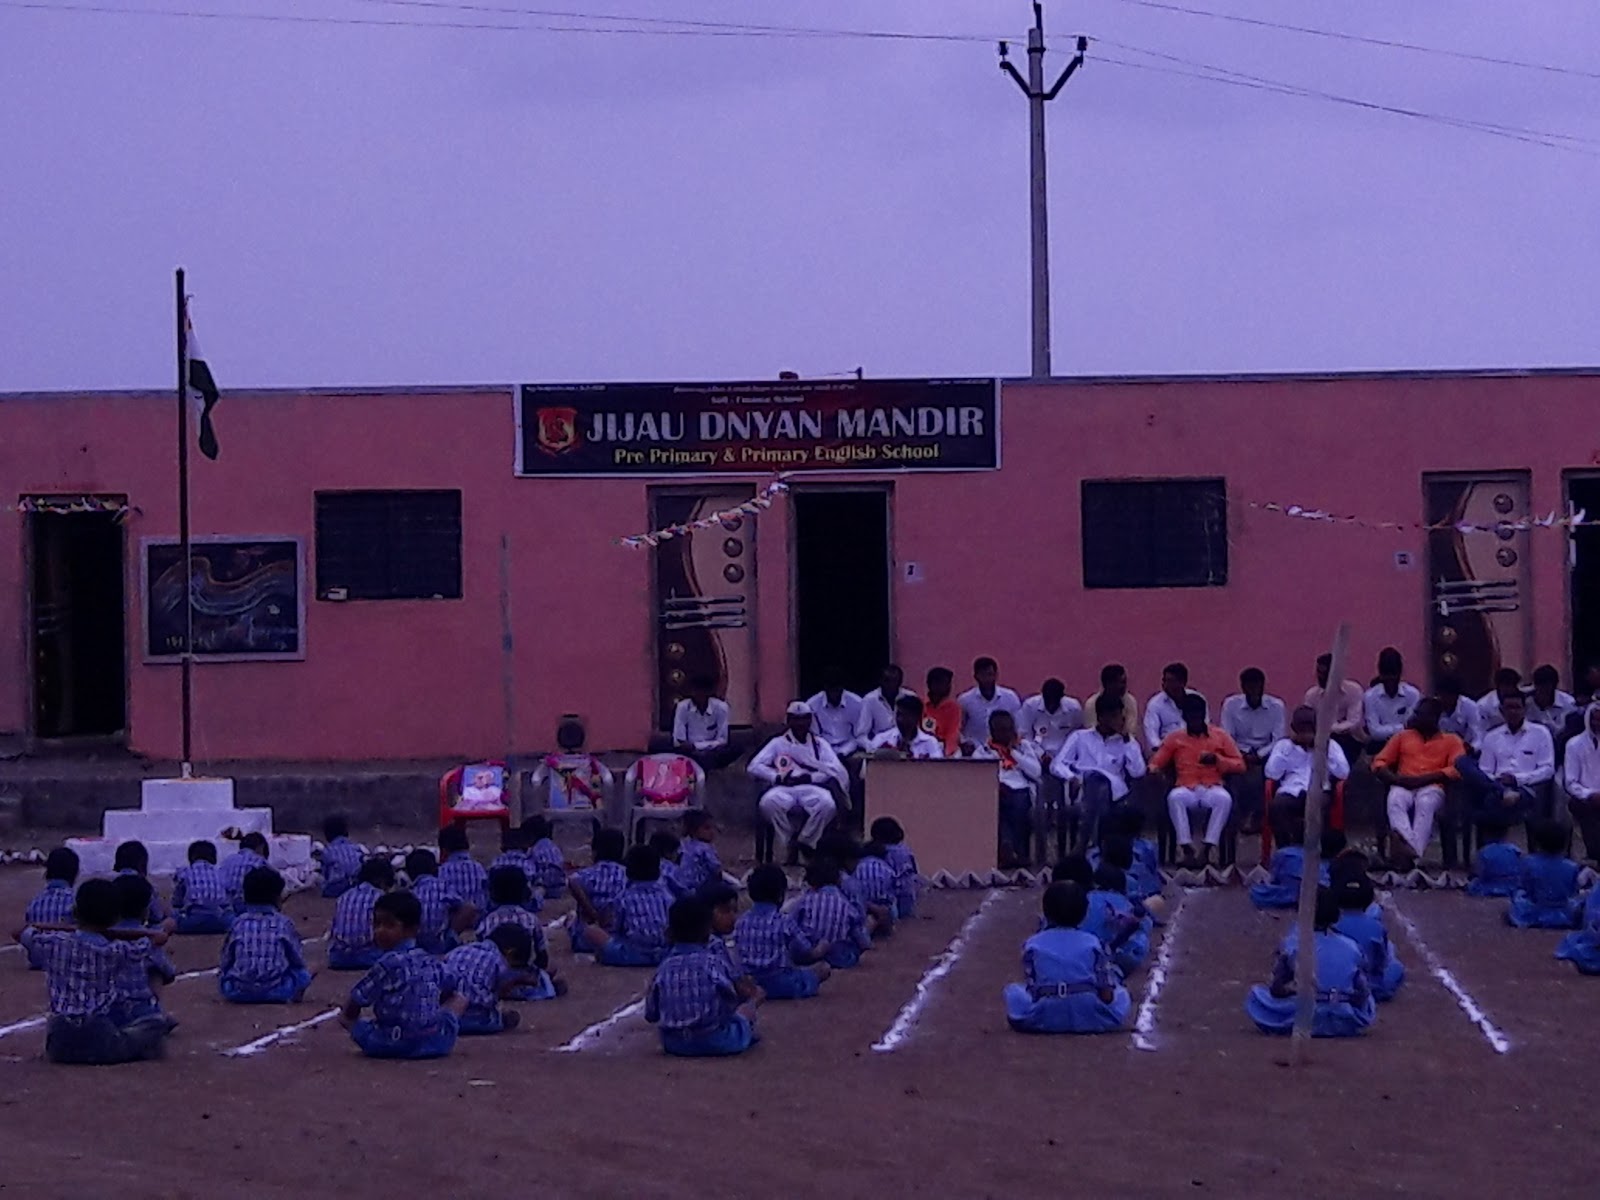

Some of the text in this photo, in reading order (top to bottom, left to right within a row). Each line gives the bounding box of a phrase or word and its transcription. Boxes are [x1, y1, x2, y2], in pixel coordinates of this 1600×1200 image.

[586, 406, 984, 441] JIJAU DNYAN MANDIR
[614, 443, 940, 465] Pre Primary & Primary English School
